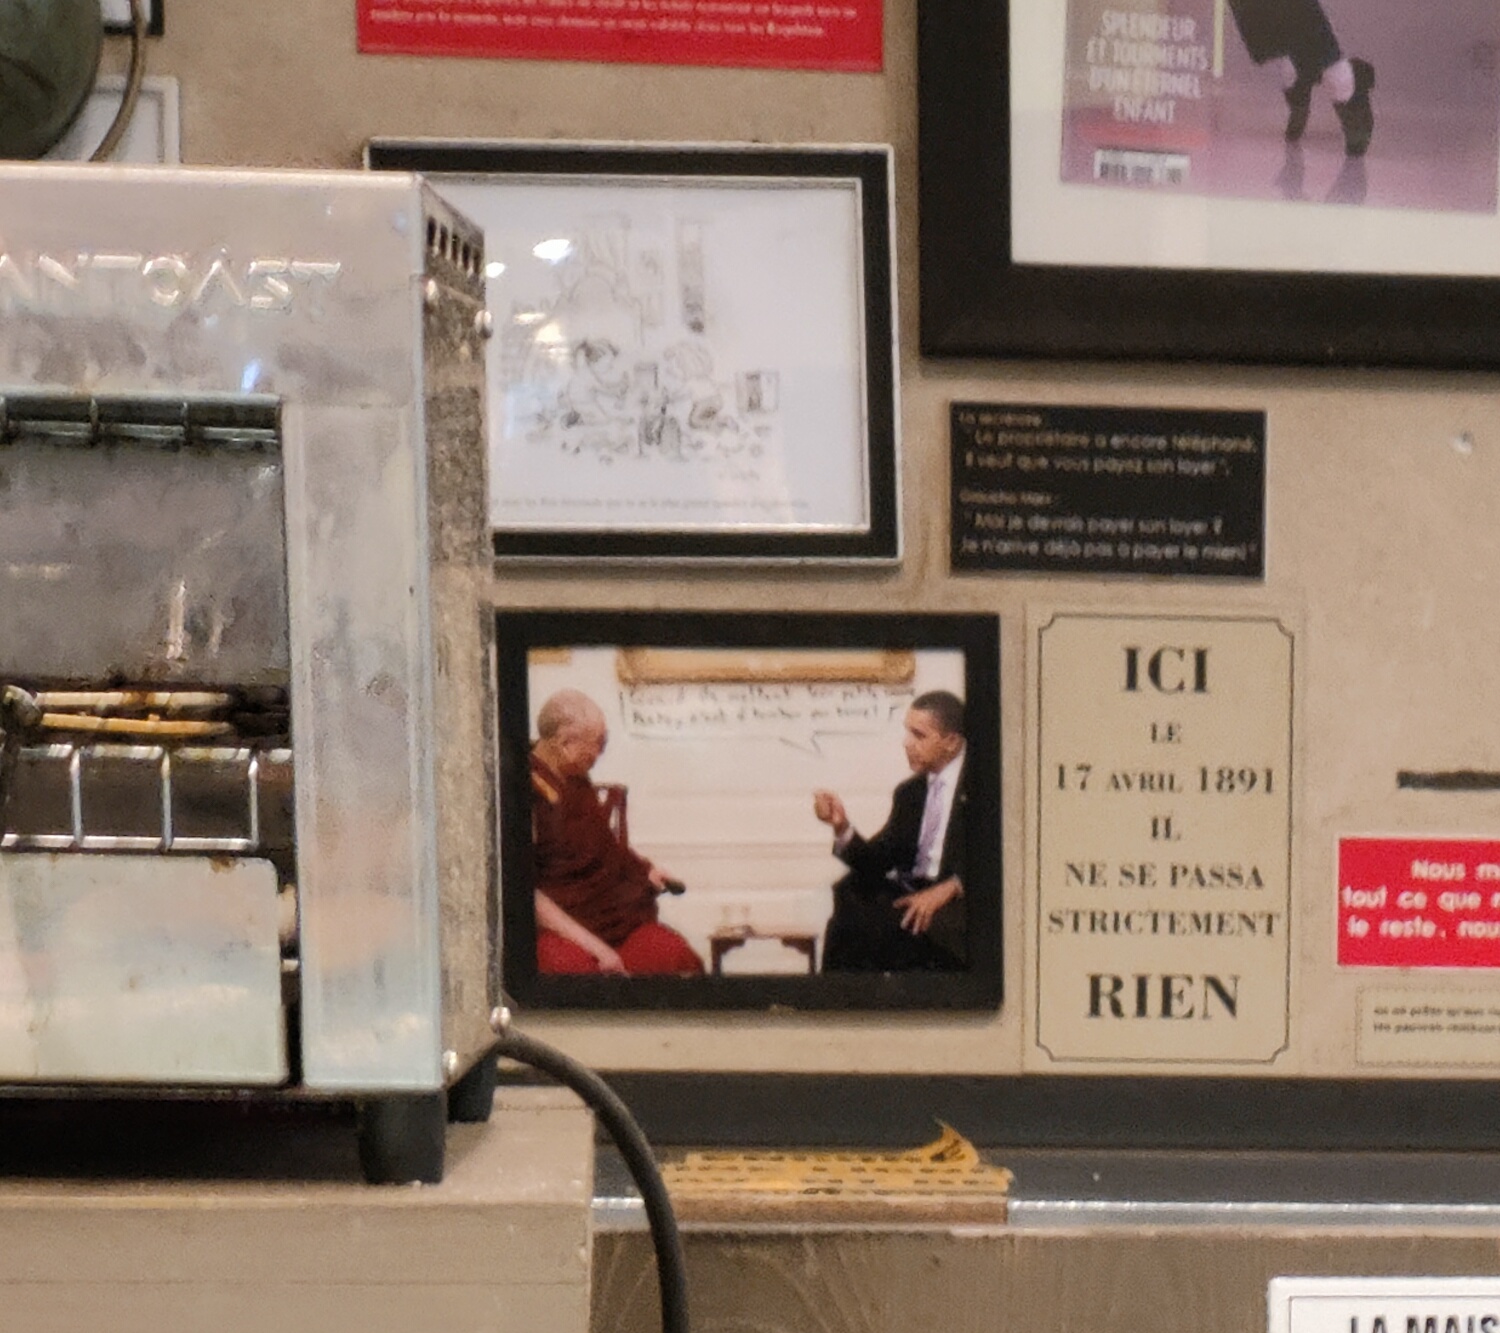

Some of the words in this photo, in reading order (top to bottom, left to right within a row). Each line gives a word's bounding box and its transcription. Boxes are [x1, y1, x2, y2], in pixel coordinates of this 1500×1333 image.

[1113, 97, 1176, 125] ENFANT
[1123, 645, 1211, 695] ICI
[1149, 721, 1182, 745] LE
[1056, 762, 1094, 792] 17
[1106, 772, 1183, 794] AVRIL
[1198, 766, 1275, 795] 1891
[1150, 815, 1180, 842] IL
[1064, 862, 1108, 888] NE
[1118, 862, 1157, 888] SE
[1169, 863, 1266, 890] PASSA
[1410, 857, 1467, 882] Nous
[1342, 884, 1388, 909] tout
[1395, 890, 1428, 910] ce
[1436, 890, 1483, 913] que
[1046, 909, 1281, 939] STRICTEMENT
[1346, 913, 1371, 938] le
[1085, 972, 1241, 1021] RIEN
